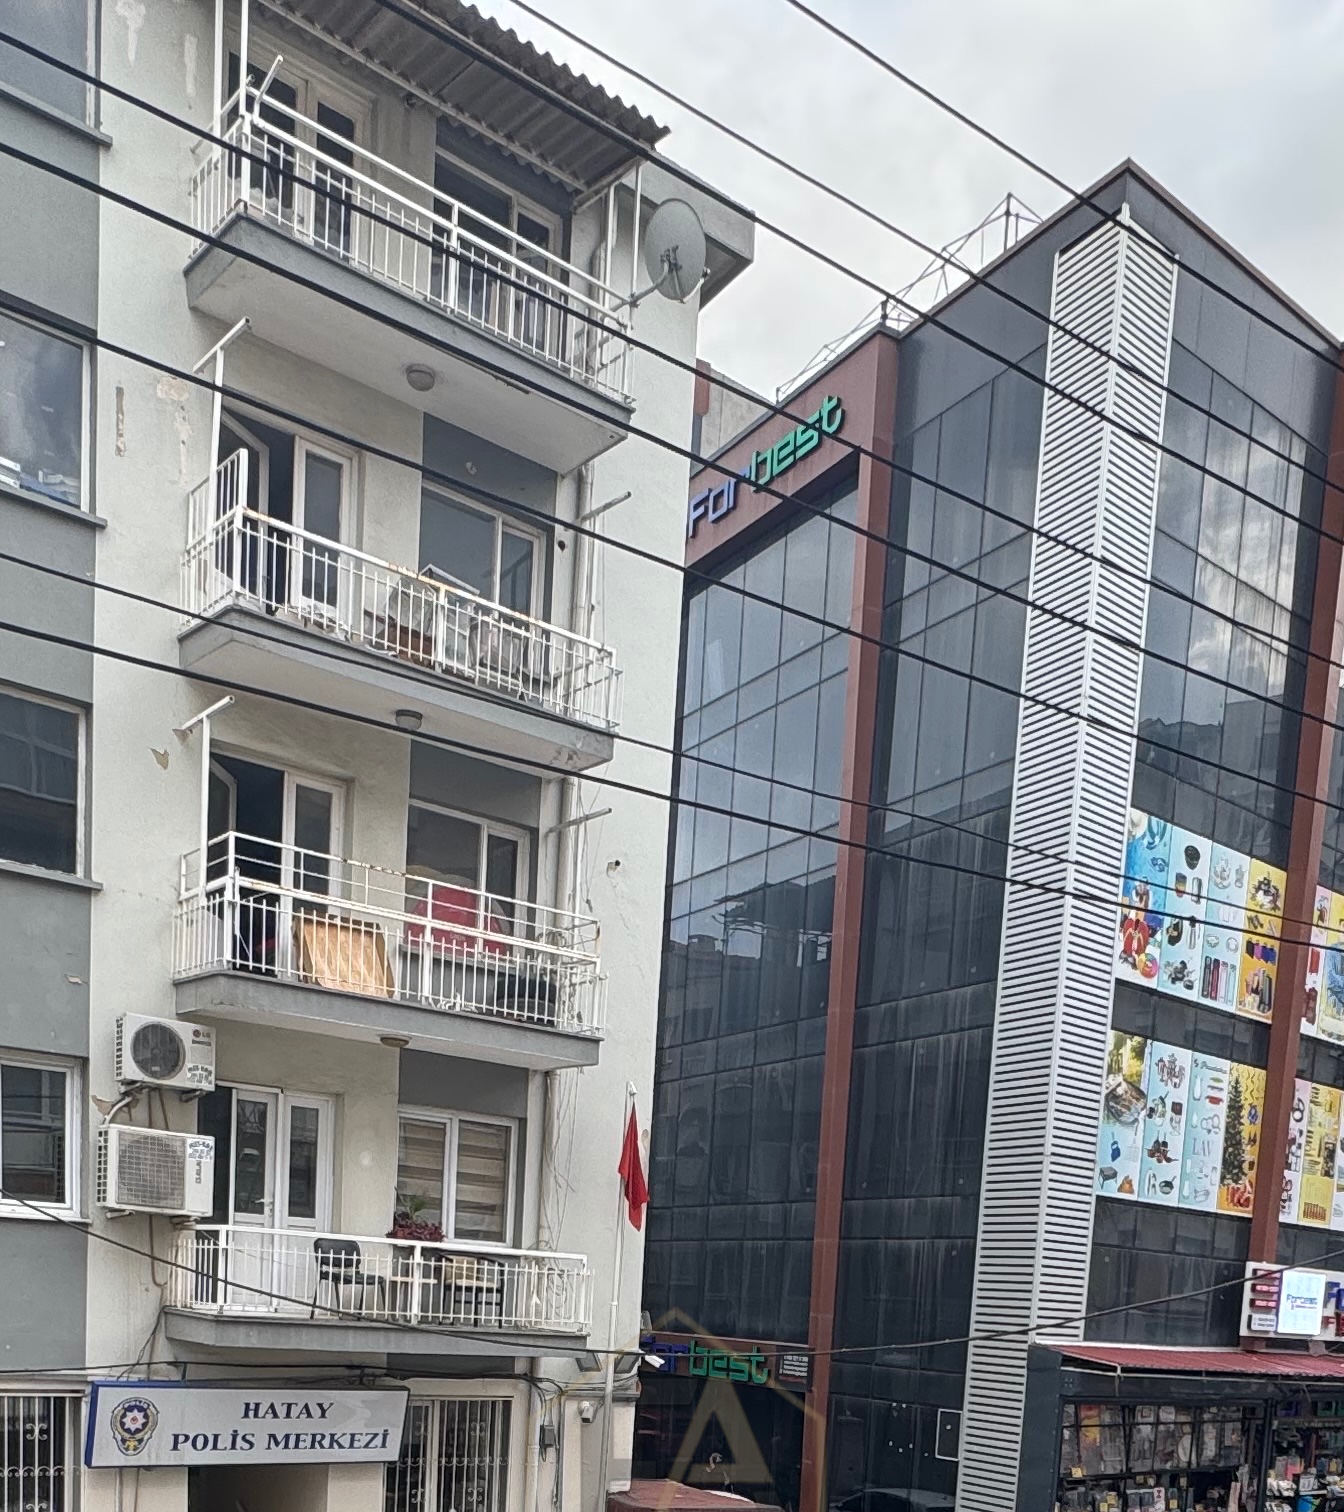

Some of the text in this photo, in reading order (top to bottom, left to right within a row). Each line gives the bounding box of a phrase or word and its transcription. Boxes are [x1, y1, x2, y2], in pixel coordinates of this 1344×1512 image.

[241, 1402, 334, 1420] HATAY
[169, 1427, 390, 1452] POLİS MERKEZİ
